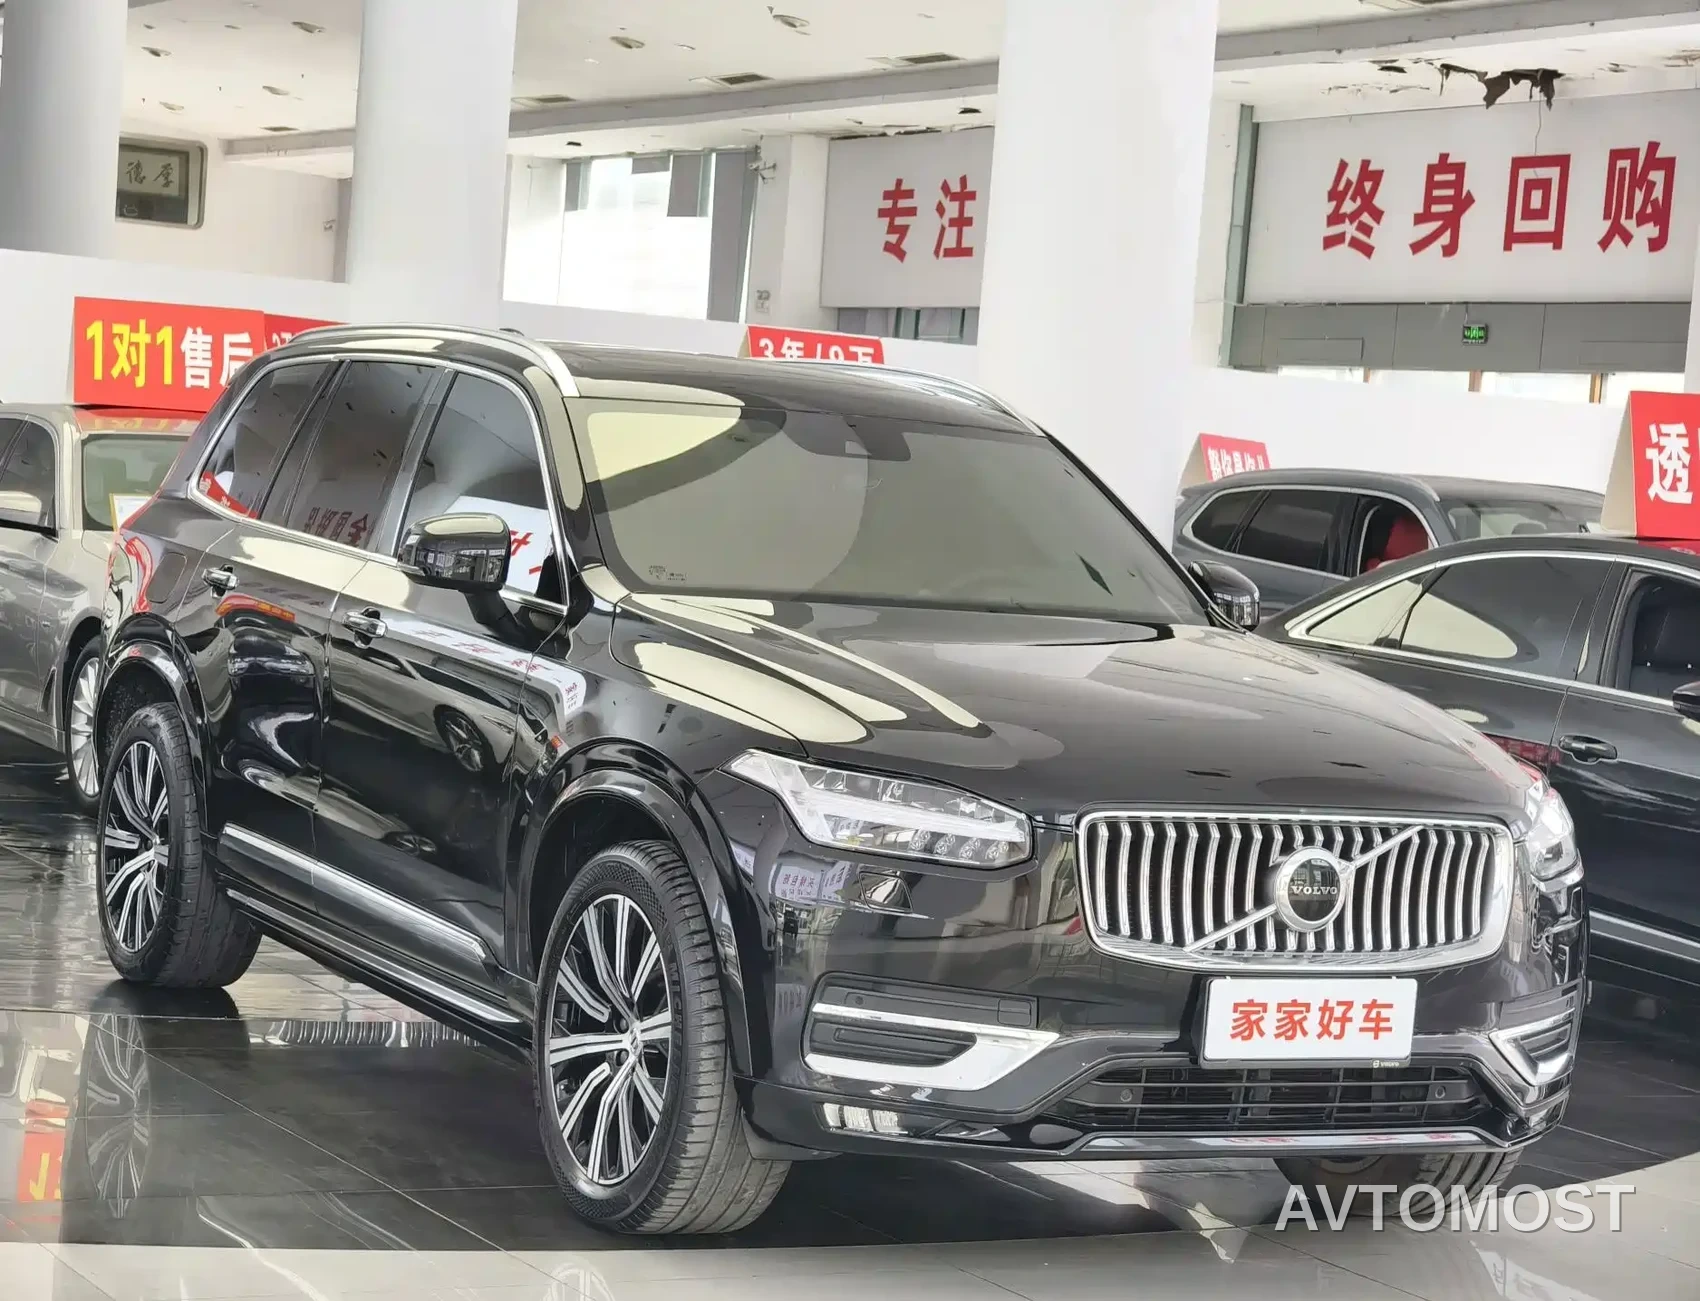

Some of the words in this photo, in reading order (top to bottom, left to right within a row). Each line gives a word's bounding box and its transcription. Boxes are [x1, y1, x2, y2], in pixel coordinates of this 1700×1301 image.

[877, 174, 977, 263] 专注
[1322, 141, 1676, 259] 终身回购
[1645, 422, 1700, 504] 透
[1291, 885, 1338, 895] VOLVO
[1230, 998, 1394, 1041] 家家好车
